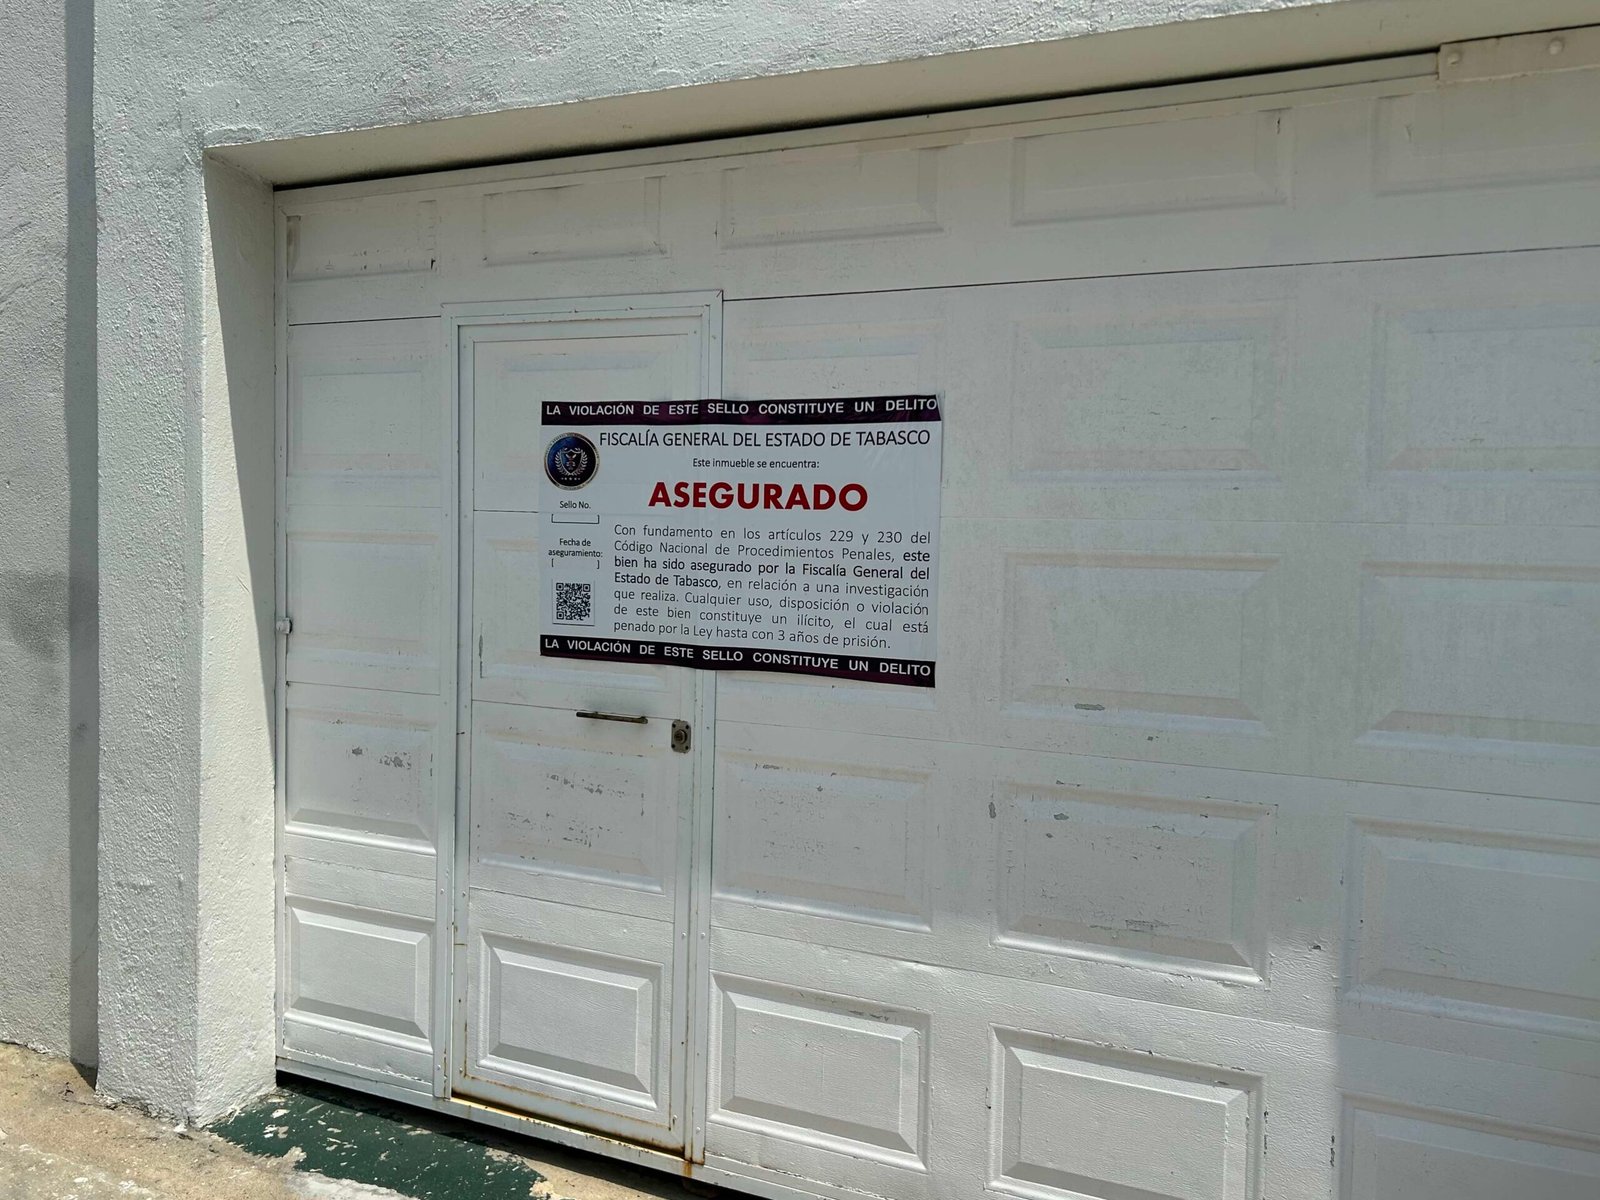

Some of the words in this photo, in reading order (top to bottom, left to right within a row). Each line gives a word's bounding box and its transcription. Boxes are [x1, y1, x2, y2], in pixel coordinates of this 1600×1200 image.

[546, 405, 561, 415] LA
[569, 403, 634, 415] VIOLACIÓN
[643, 405, 659, 414] DE
[669, 404, 699, 414] ESTE
[708, 403, 749, 414] SELLO
[758, 402, 844, 414] CONSTITUYE
[854, 401, 874, 412] UN
[886, 399, 937, 411] DELITO
[600, 429, 659, 446] FISCALÍA
[663, 432, 728, 446] GENERAL
[733, 433, 761, 446] DEL
[766, 432, 825, 446] ESTADO
[831, 432, 851, 446] DE
[856, 430, 930, 446] TABASCO
[693, 458, 710, 467] Este
[713, 458, 754, 468] inmueble
[757, 460, 767, 468] se
[770, 460, 819, 468] encuentra:
[579, 501, 591, 509] No.
[648, 482, 868, 512] ASEGURADO
[560, 538, 580, 546] Fecha
[614, 524, 635, 535] Con
[643, 525, 712, 538] fundamento
[721, 529, 735, 538] en
[744, 528, 760, 539] los
[768, 529, 821, 542] artículos
[830, 531, 853, 542] 229
[862, 534, 868, 545] y
[878, 531, 902, 543] 230
[911, 532, 930, 544] del
[548, 549, 603, 558] aseguramiento:
[614, 540, 652, 554] Código
[660, 542, 707, 554] Nacional
[715, 543, 730, 555] de
[738, 545, 834, 558] Procedimientos
[842, 548, 894, 562] Penales,
[903, 550, 930, 561] este
[614, 556, 638, 567] bien
[644, 557, 656, 568] ha
[662, 558, 684, 569] sido
[690, 560, 751, 573] asegurado
[758, 564, 779, 575] por
[786, 562, 795, 574] la
[802, 563, 846, 576] Fiscalía
[853, 566, 902, 579] General
[910, 567, 929, 580] del
[614, 572, 650, 584] Estado
[655, 574, 668, 586] de
[673, 575, 721, 589] Tabasco,
[727, 580, 742, 588] en
[749, 579, 796, 591] relación
[803, 583, 809, 592] a
[816, 584, 839, 593] una
[846, 583, 929, 598] investigación
[614, 590, 634, 601] que
[641, 590, 678, 602] realiza.
[685, 592, 741, 606] Cualquier
[748, 598, 772, 608] uso,
[780, 596, 849, 611] disposición
[857, 603, 864, 612] o
[872, 602, 929, 615] violación
[614, 604, 628, 614] de
[636, 607, 658, 616] este
[668, 607, 690, 619] bien
[700, 610, 762, 625] constituye
[772, 616, 786, 624] un
[797, 614, 834, 629] ilícito,
[844, 618, 855, 629] el
[866, 619, 892, 631] cual
[903, 622, 928, 633] está
[614, 621, 655, 633] penado
[659, 624, 677, 635] por
[681, 624, 690, 635] la
[693, 626, 712, 639] Ley
[717, 626, 748, 638] hasta
[752, 630, 773, 640] con
[778, 630, 785, 640] 3
[790, 630, 818, 644] años
[823, 633, 838, 645] de
[843, 634, 890, 649] prisión.
[545, 639, 559, 648] LA
[567, 640, 631, 654] VIOLACIÓN
[640, 645, 655, 655] DE
[664, 646, 694, 658] ESTE
[702, 650, 743, 661] SELLO
[753, 652, 839, 669] CONSTITUYE
[849, 660, 868, 671] UN
[880, 662, 931, 676] DELITO
